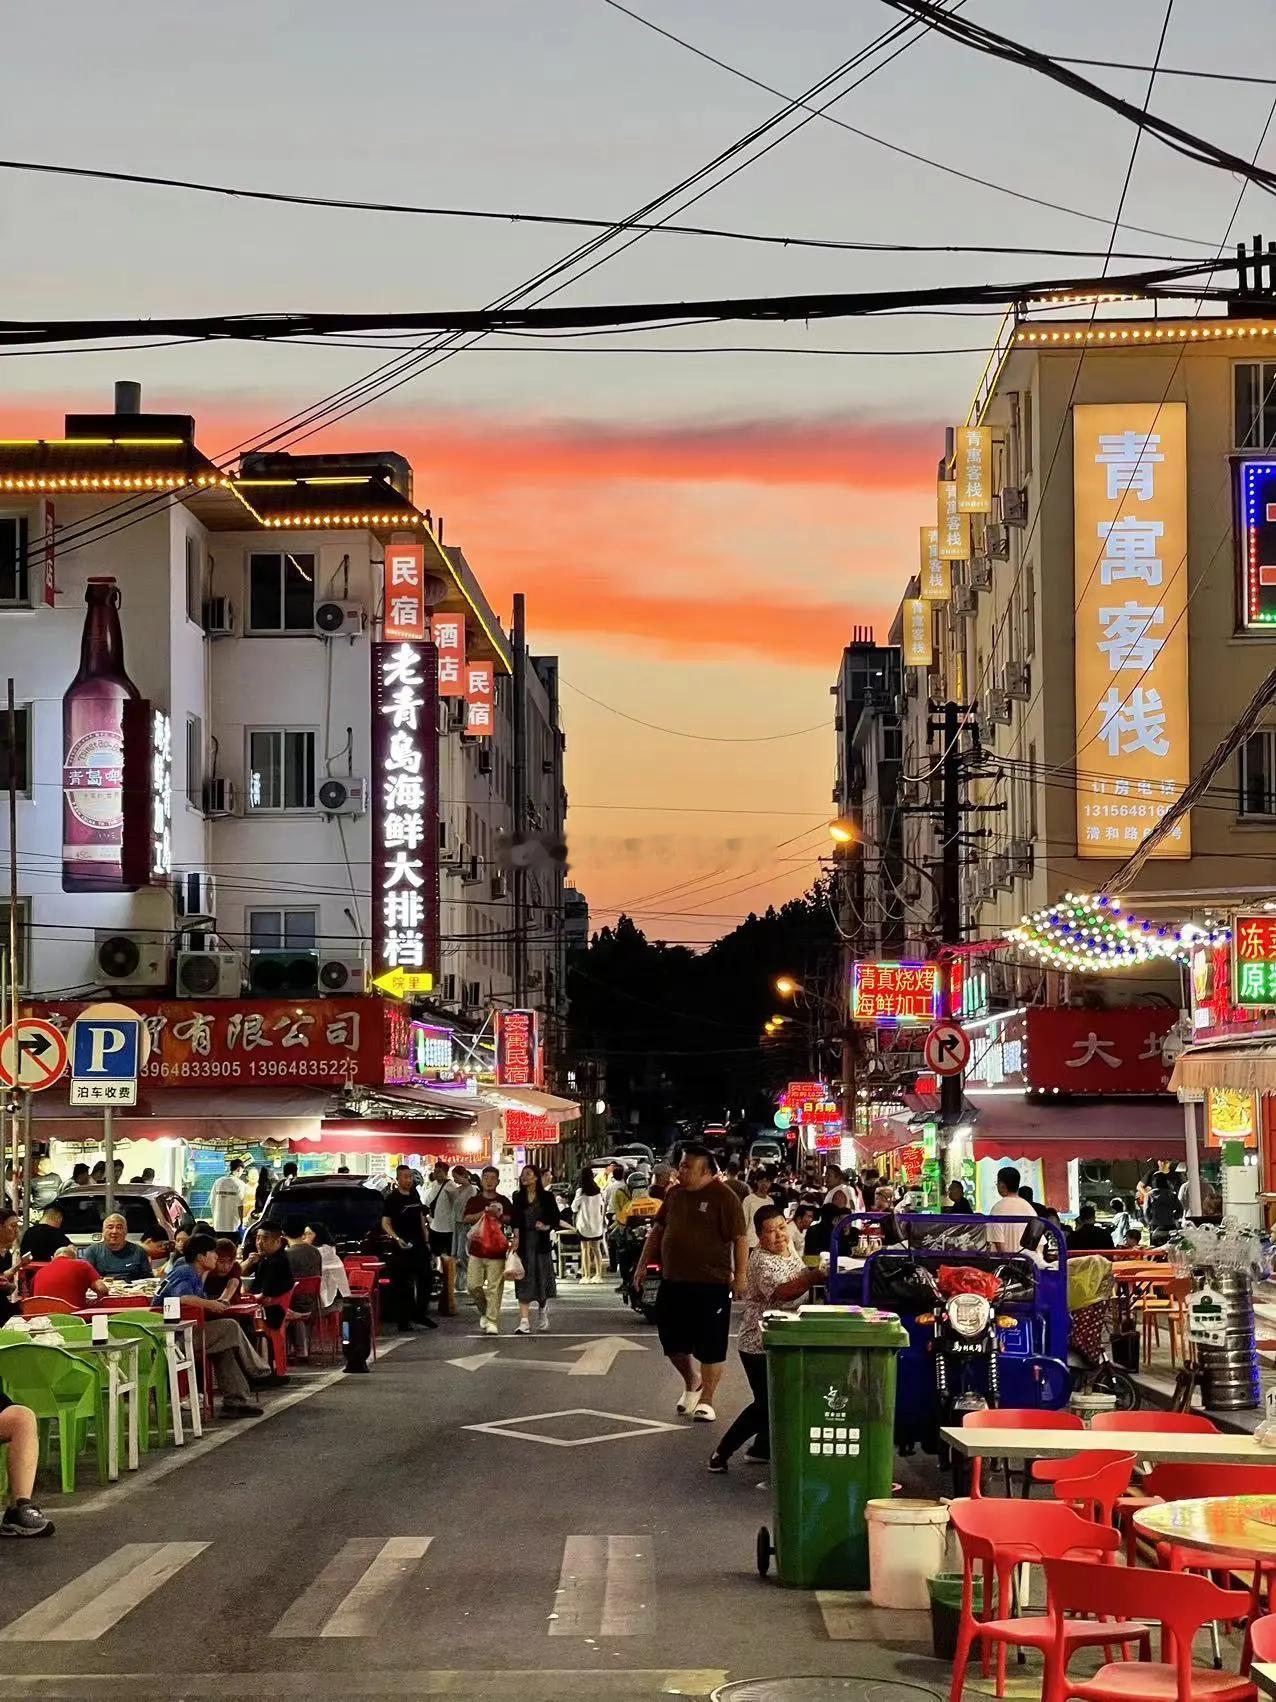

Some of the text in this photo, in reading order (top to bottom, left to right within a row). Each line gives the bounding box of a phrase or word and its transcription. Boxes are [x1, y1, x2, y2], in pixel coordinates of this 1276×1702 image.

[390, 556, 419, 626] 民宿
[1095, 431, 1169, 757] 青寓客栈
[434, 623, 459, 683] 酒店
[468, 671, 490, 726] 民宿
[1084, 804, 1172, 817] 131564816
[857, 967, 934, 992] 清真烧烤
[857, 992, 933, 1017] 海鲜加工
[86, 1027, 126, 1072] P
[140, 1059, 359, 1077] 3964833905 13964835225
[77, 1086, 130, 1099] 泊车收费
